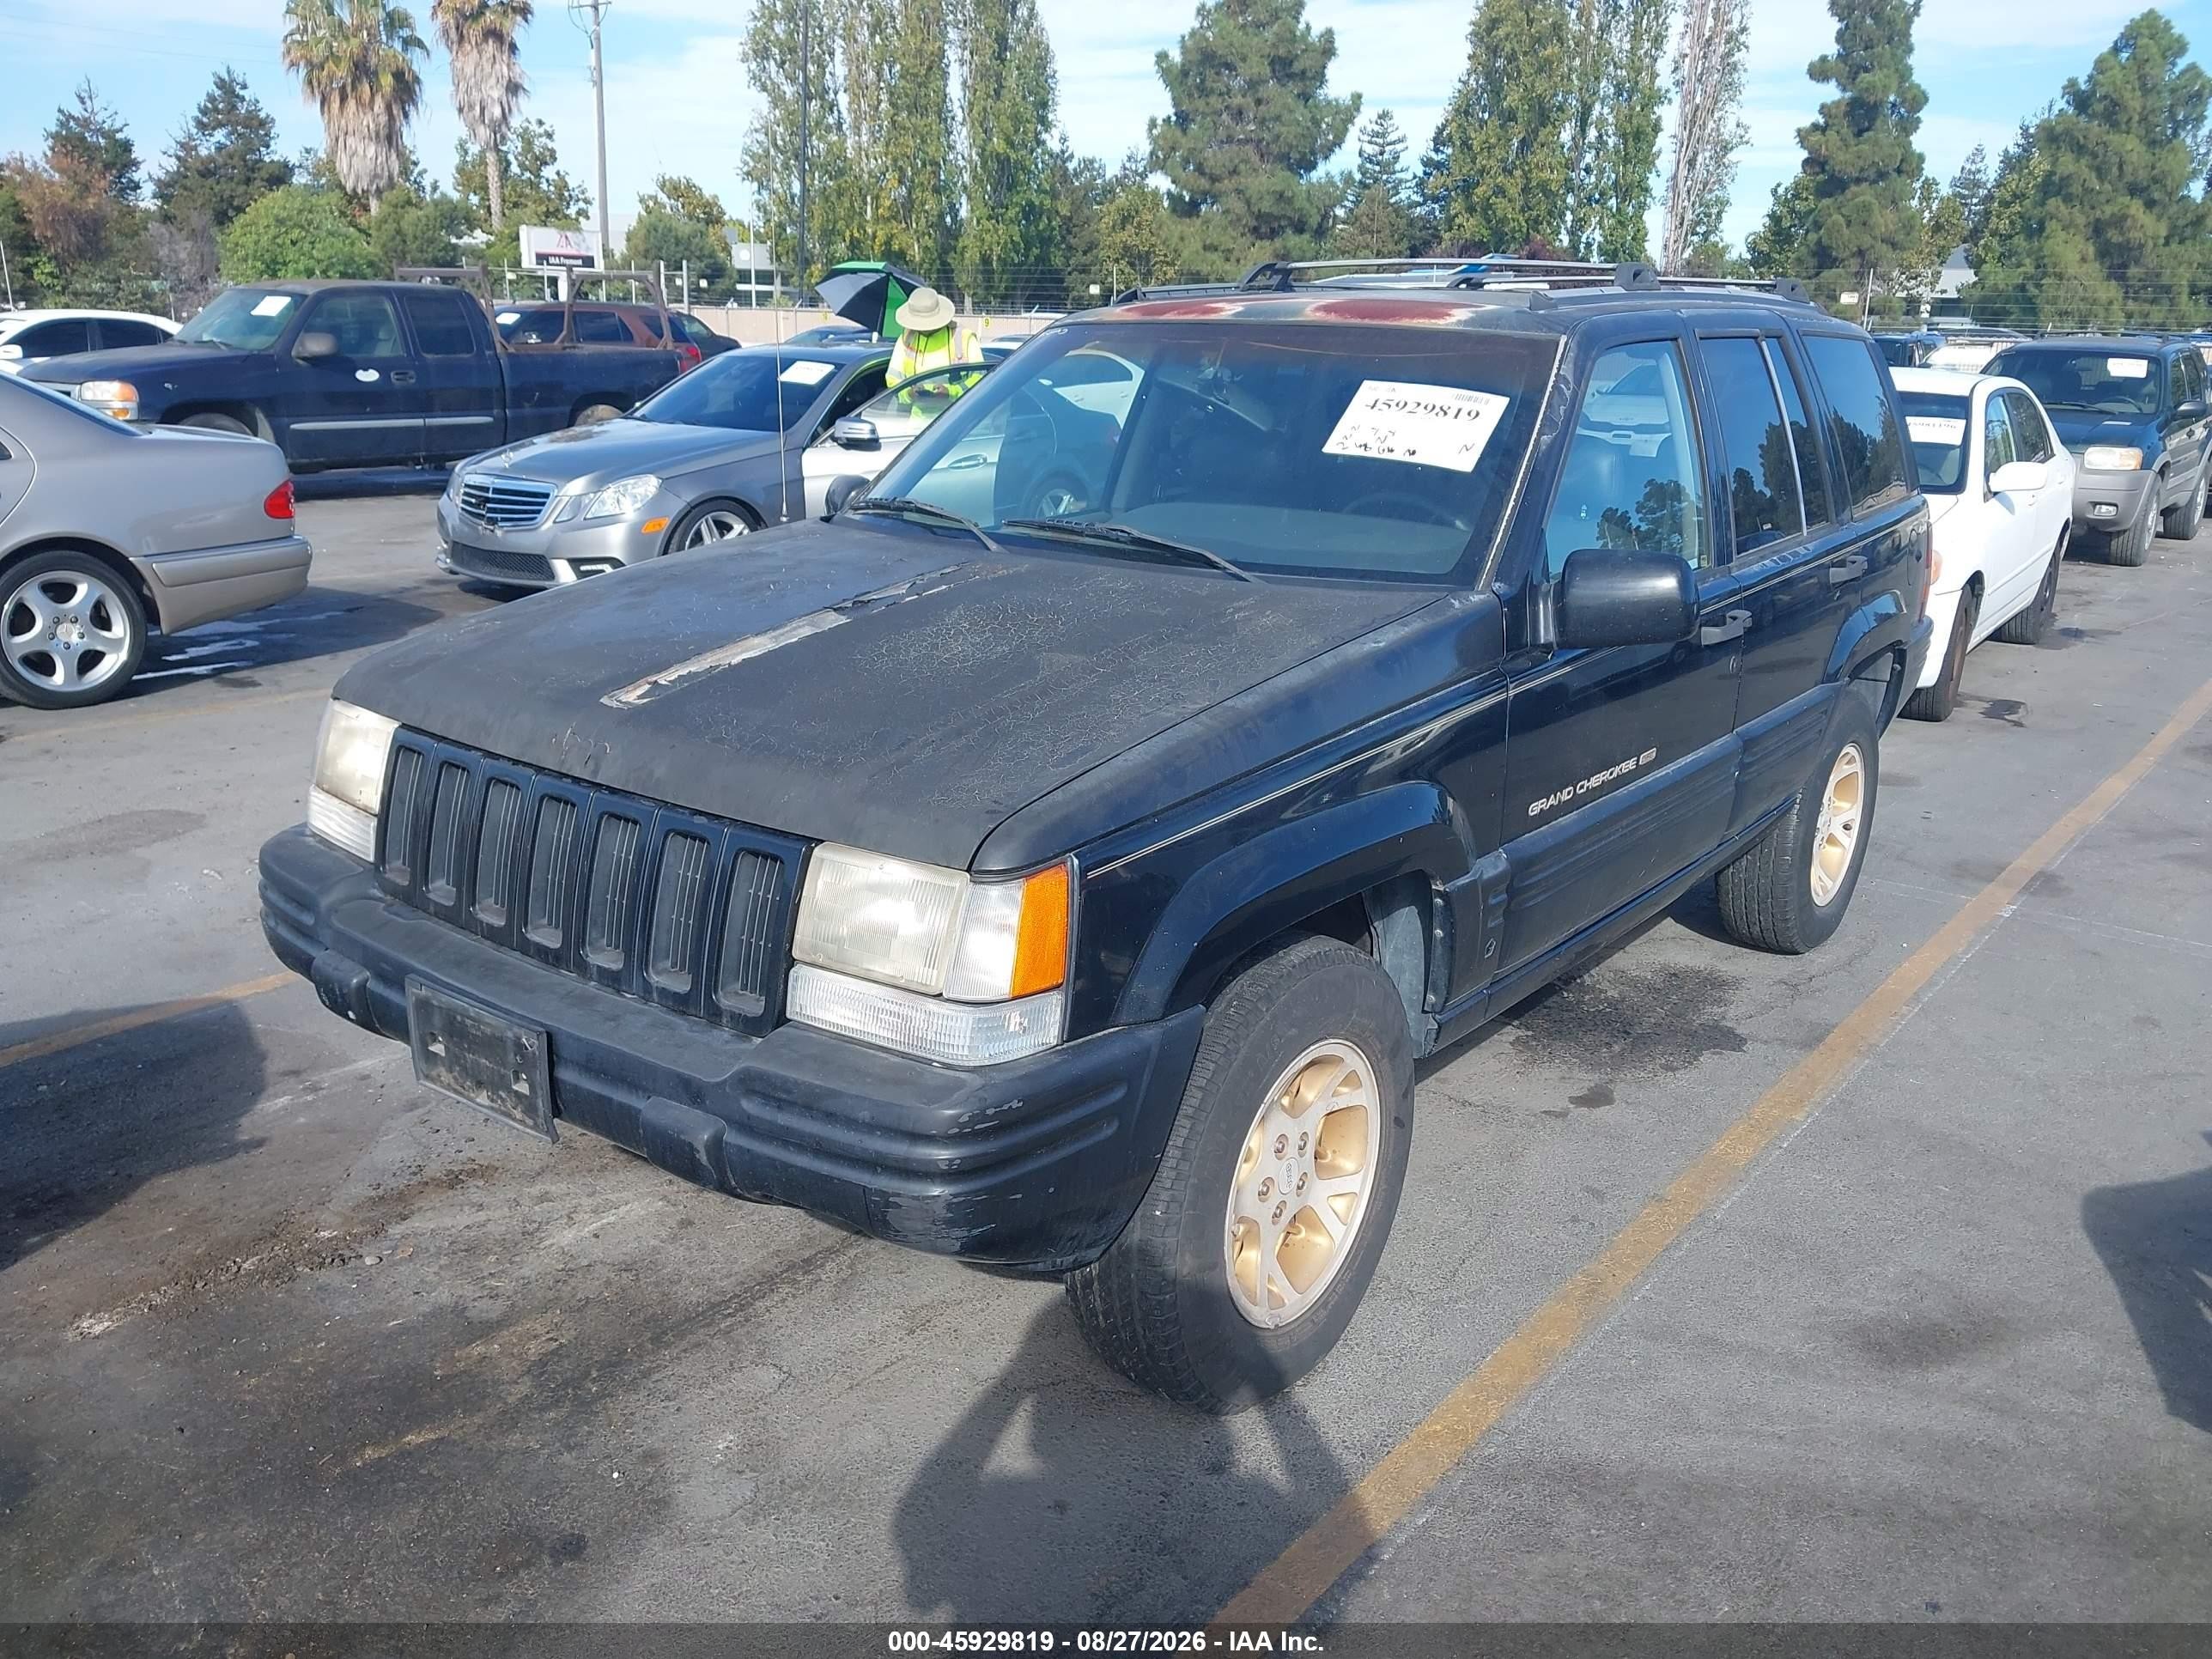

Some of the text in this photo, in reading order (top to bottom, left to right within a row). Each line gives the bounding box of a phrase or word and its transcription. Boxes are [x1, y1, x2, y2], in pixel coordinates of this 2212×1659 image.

[1365, 398, 1480, 421] 45929819
[1528, 757, 1638, 817] GRAND CHEROKEE
